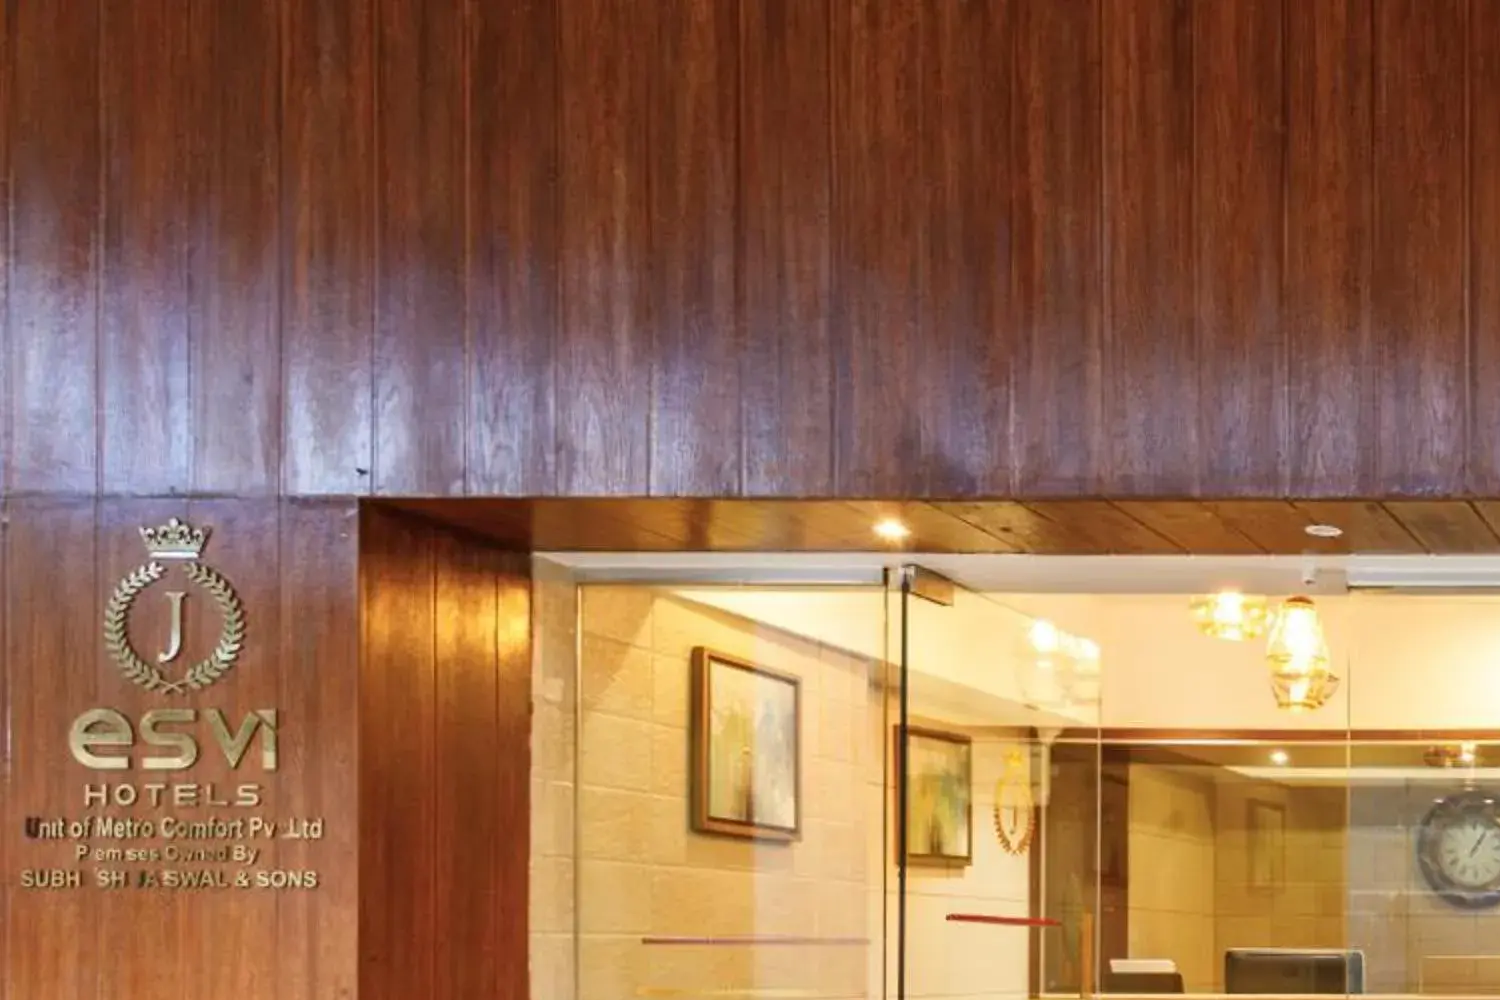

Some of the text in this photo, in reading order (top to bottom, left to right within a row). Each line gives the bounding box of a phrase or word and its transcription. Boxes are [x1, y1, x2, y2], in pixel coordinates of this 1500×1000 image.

[157, 591, 187, 663] J
[84, 783, 262, 807] HOTELS
[25, 816, 65, 839] Unit
[70, 816, 93, 838] of
[97, 817, 154, 839] Metro
[161, 816, 244, 839] Comfort
[232, 844, 260, 865] By
[20, 868, 128, 888] SUBHSH
[234, 870, 250, 887] &
[256, 869, 318, 888] SONS
